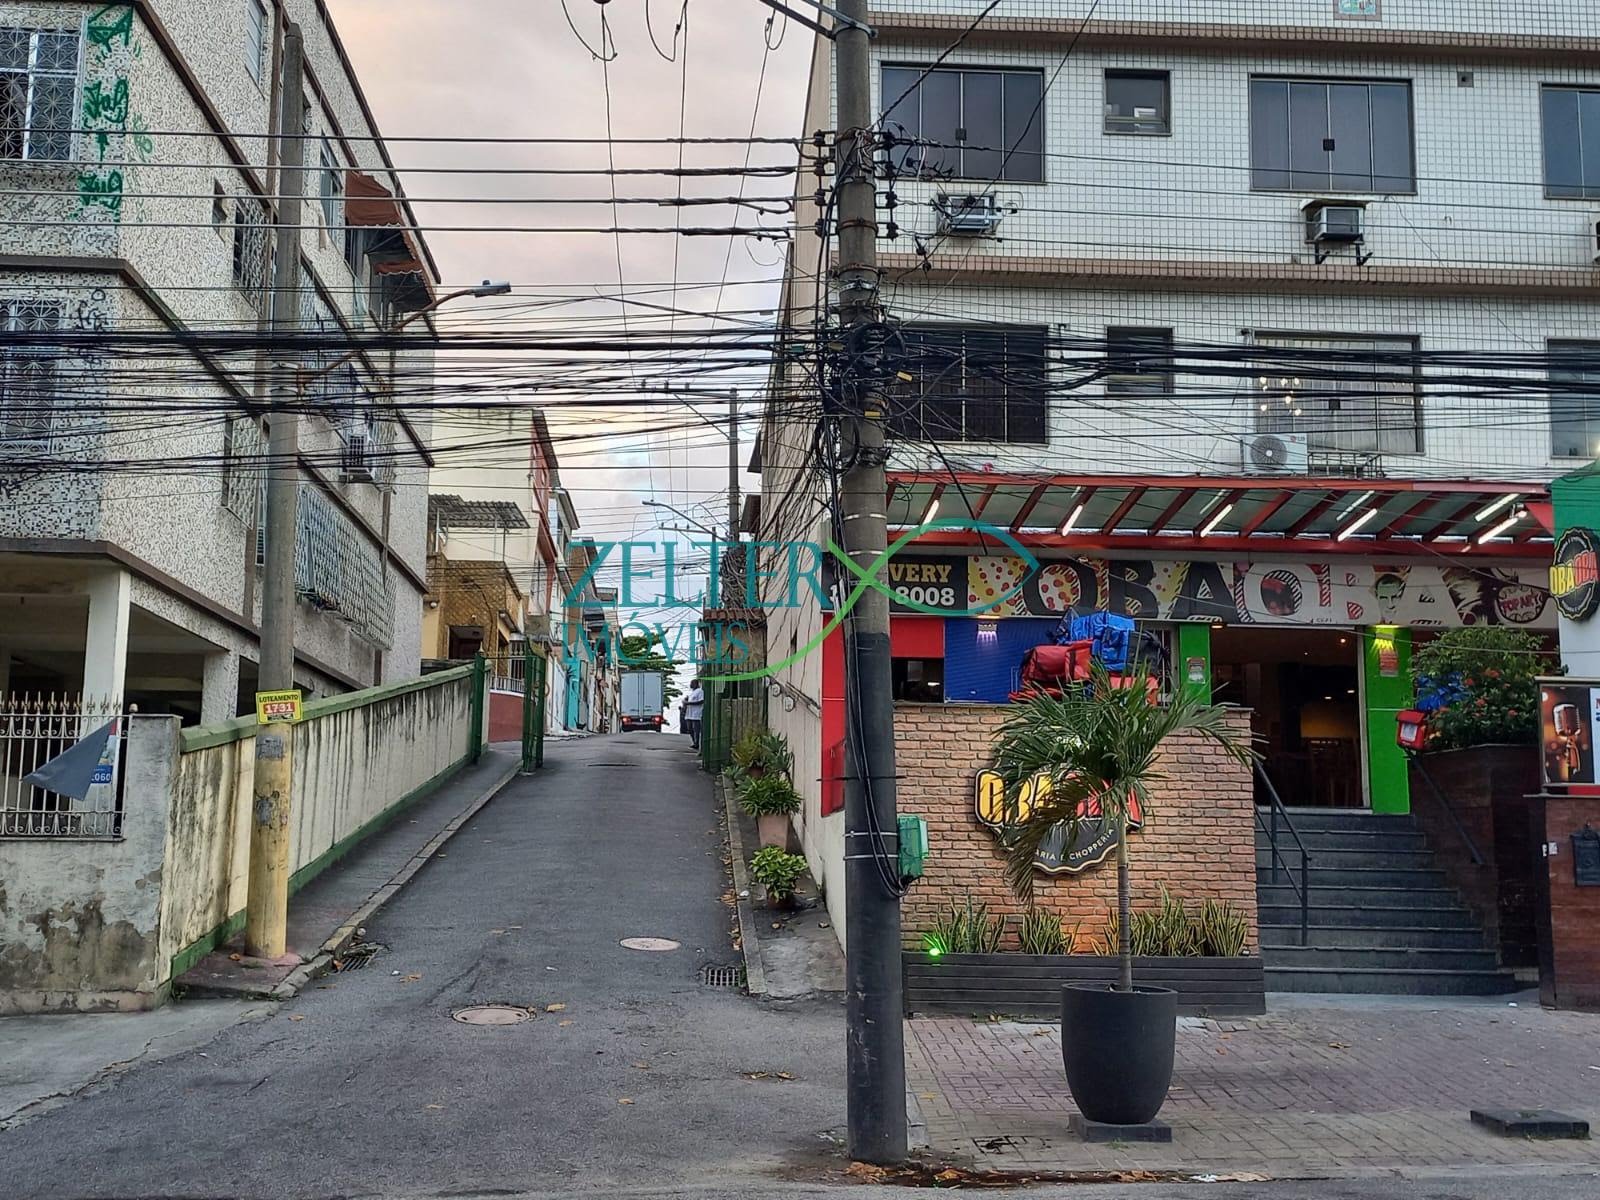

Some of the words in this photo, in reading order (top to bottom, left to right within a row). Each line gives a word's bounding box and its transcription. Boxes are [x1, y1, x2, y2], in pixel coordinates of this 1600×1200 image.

[888, 562, 952, 583] VERY
[1549, 563, 1575, 596] OBA
[1575, 552, 1598, 586] OBA
[91, 772, 111, 782] 060
[1069, 828, 1115, 861] CHOPPERIA
